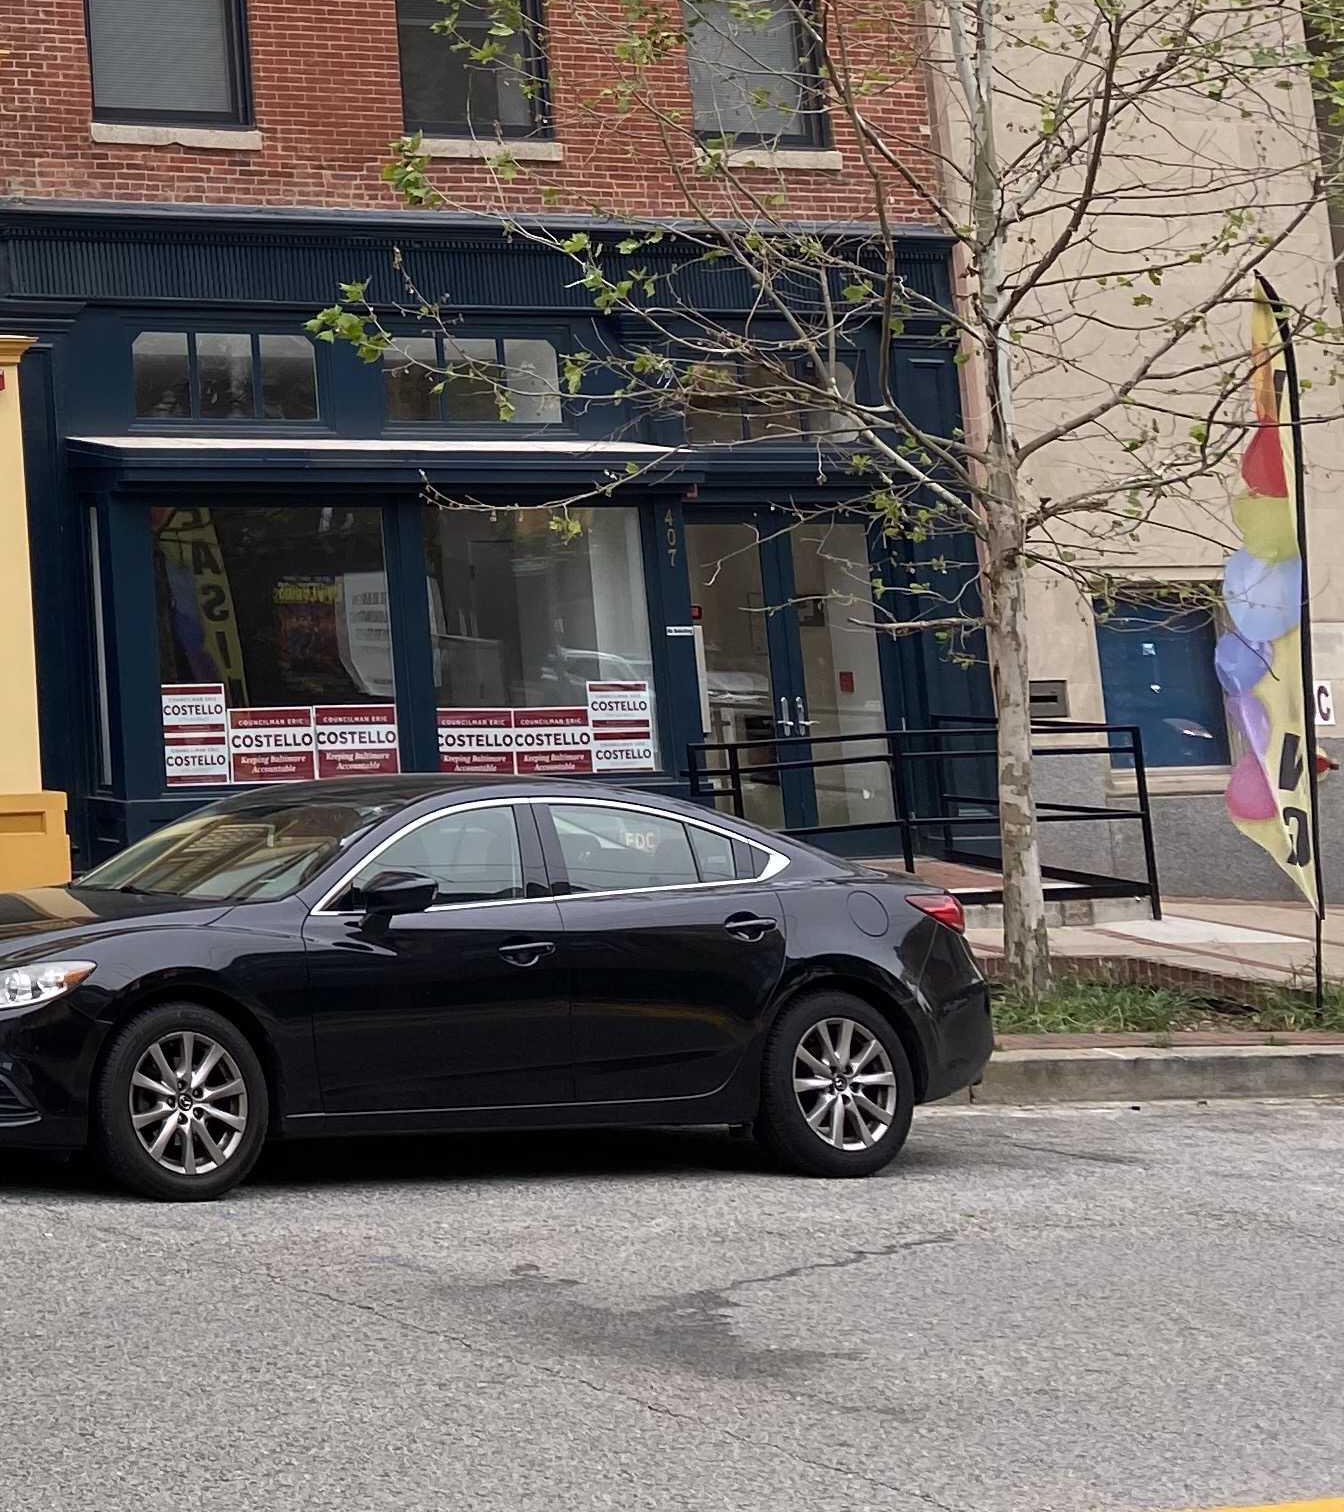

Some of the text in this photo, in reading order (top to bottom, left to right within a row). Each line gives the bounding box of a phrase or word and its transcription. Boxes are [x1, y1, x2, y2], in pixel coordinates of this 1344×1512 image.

[665, 509, 677, 568] 407
[163, 704, 223, 716] COSTELLO
[591, 700, 647, 711] COSTELLO
[231, 732, 313, 748] COSTELLO
[317, 730, 397, 745] COSTELLO
[514, 732, 591, 747] COSTELLO
[166, 754, 226, 767] COSTELLO
[595, 748, 652, 760] COSTELLO
